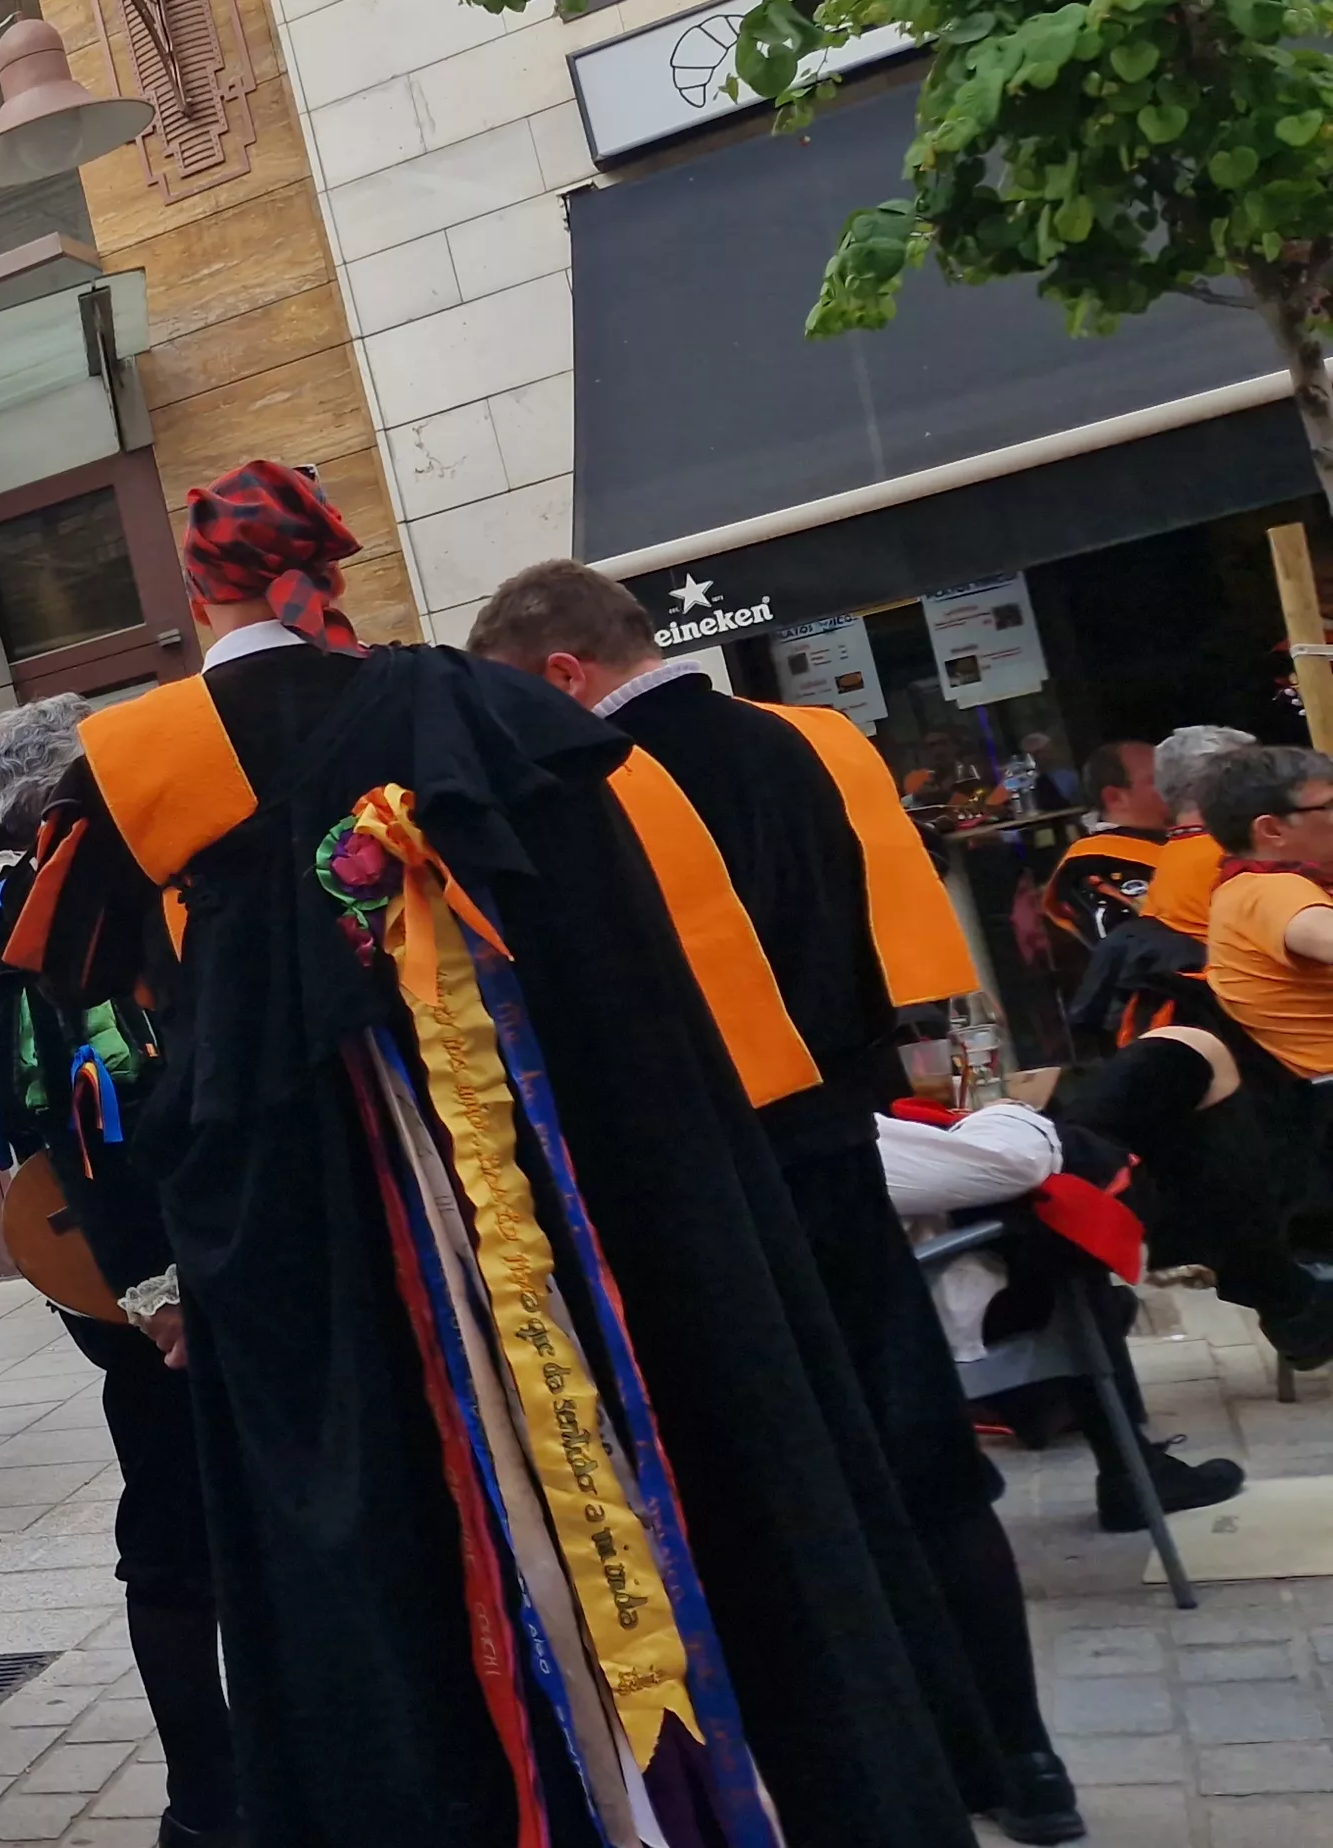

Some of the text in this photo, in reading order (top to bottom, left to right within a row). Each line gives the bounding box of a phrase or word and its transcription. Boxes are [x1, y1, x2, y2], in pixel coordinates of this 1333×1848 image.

[654, 602, 773, 647] eineken
[515, 1317, 555, 1358] que
[543, 1362, 572, 1394] da
[585, 1503, 605, 1523] a
